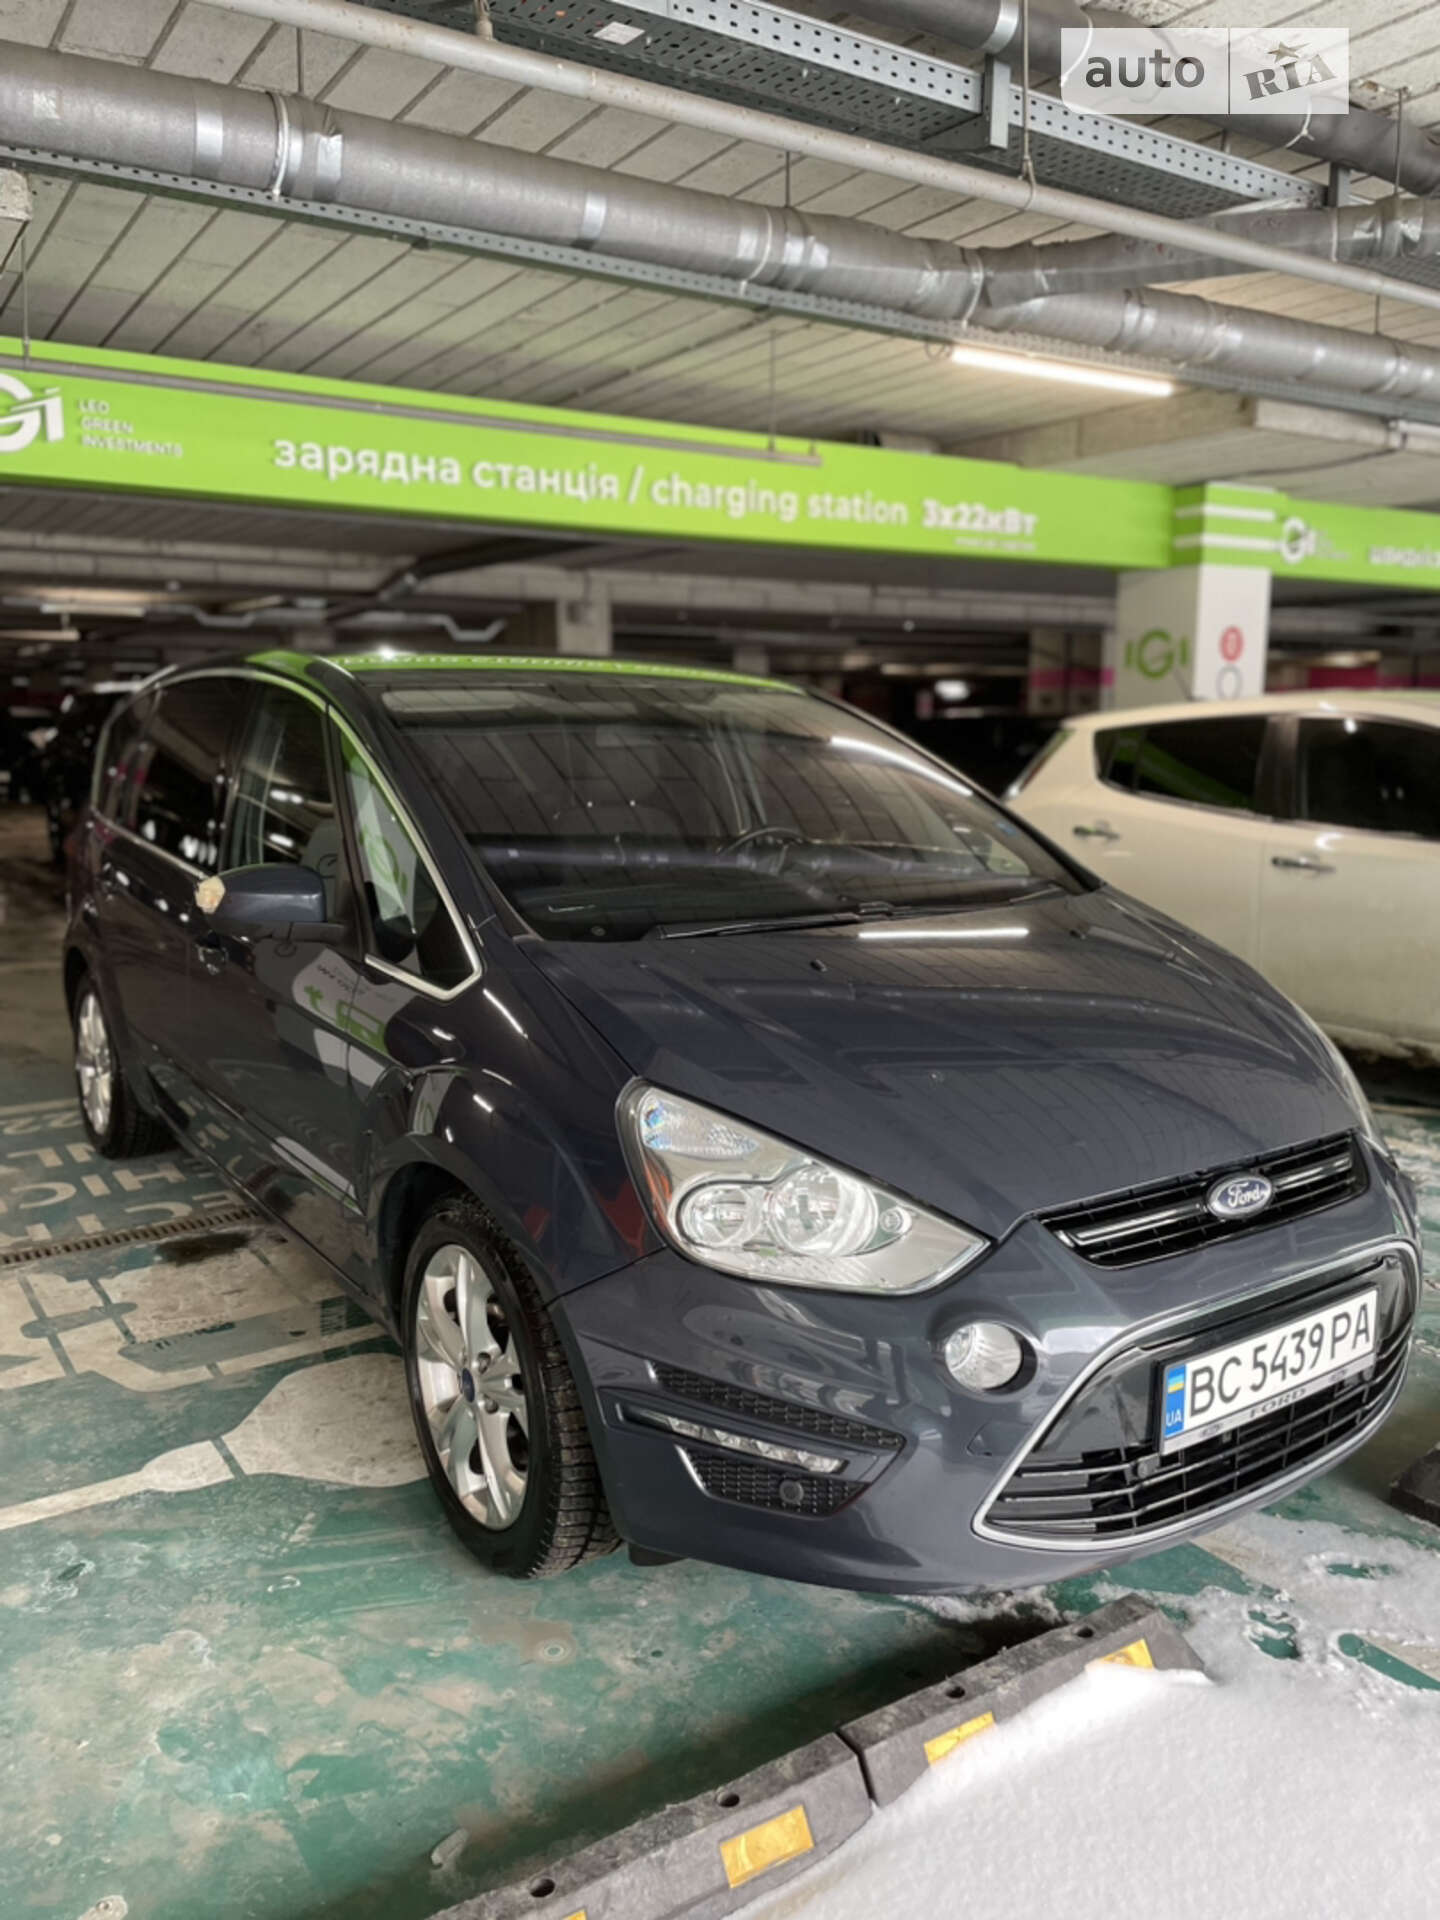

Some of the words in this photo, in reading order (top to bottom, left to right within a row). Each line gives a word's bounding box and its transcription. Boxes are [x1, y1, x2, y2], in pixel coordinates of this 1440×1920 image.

[274, 439, 462, 485] зарядна
[471, 461, 620, 502] станція
[650, 472, 799, 523] charging
[807, 490, 909, 526] station
[1227, 1181, 1266, 1208] Ford
[1189, 1356, 1242, 1417] BC
[1249, 1322, 1325, 1392] 5439
[1330, 1302, 1370, 1359] PA
[1165, 1408, 1183, 1427] UA
